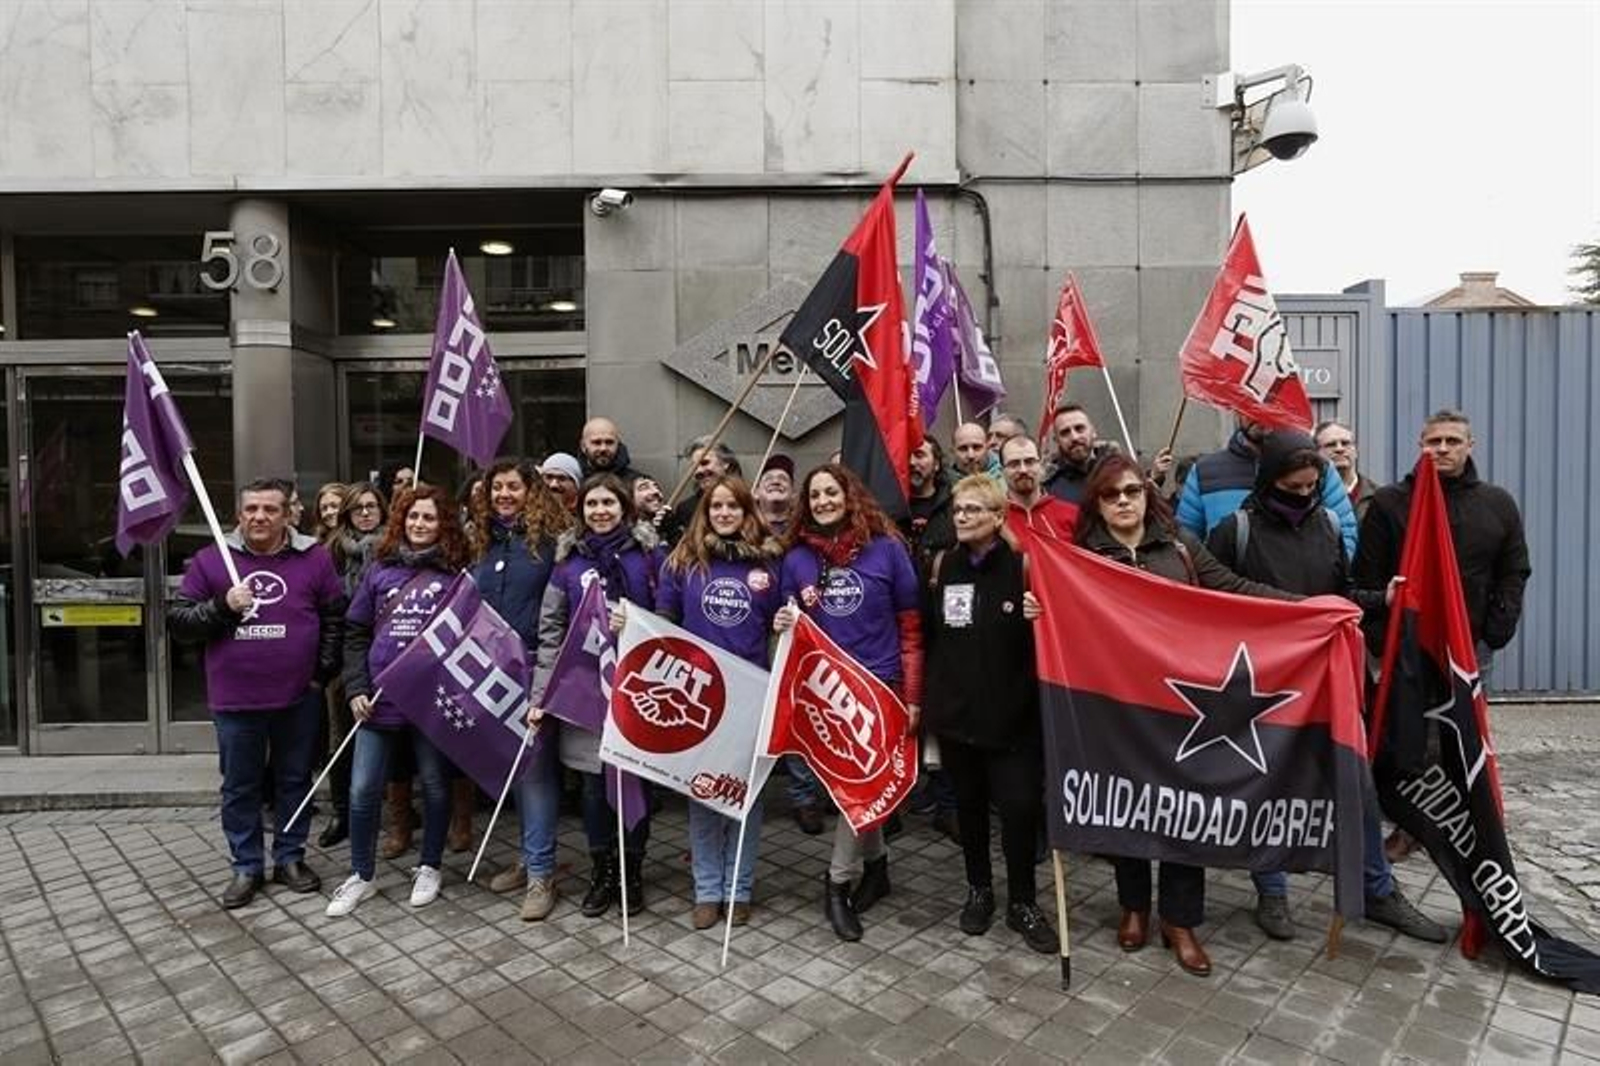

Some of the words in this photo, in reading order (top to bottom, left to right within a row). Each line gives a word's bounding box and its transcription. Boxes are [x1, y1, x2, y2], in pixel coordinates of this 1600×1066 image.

[200, 230, 284, 290] 58
[736, 342, 816, 376] Me
[640, 648, 713, 703] UGT
[805, 658, 877, 746] UGT
[1062, 768, 1249, 848] SOLIDARIDAD
[1396, 763, 1478, 859] RIDAD
